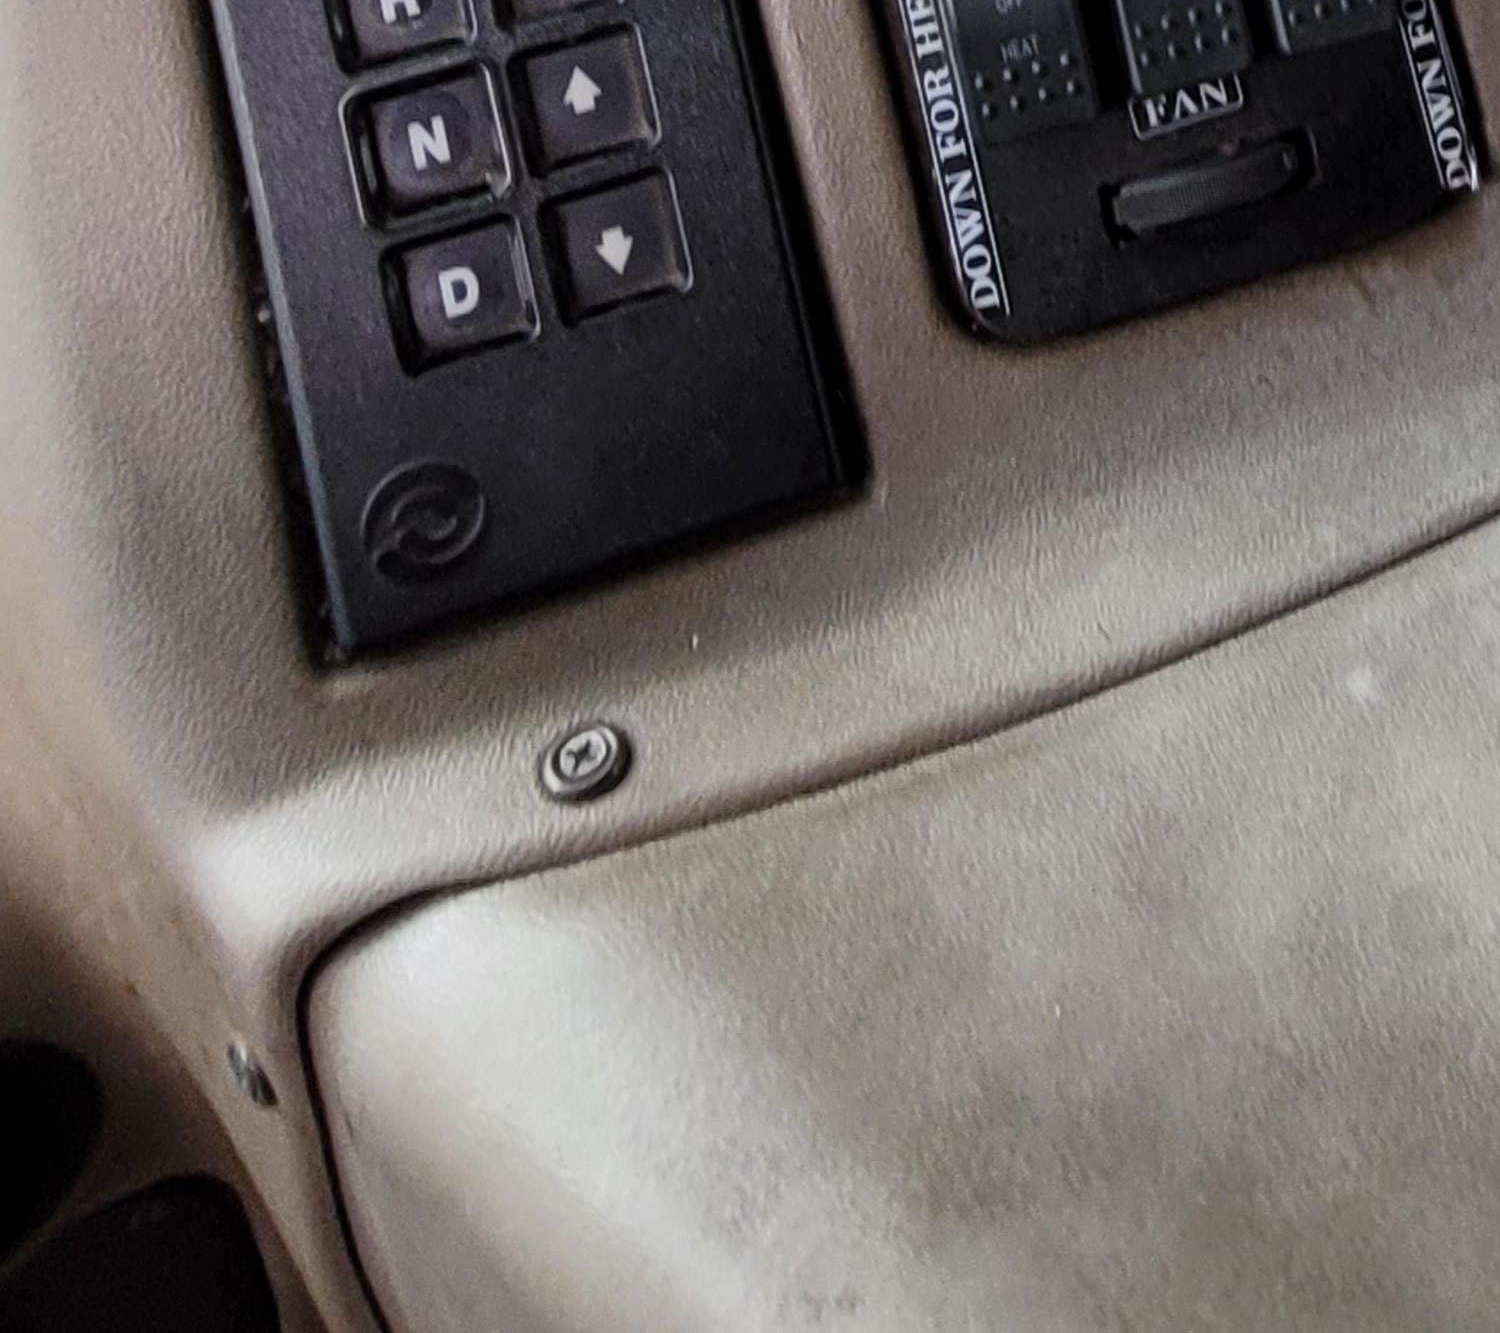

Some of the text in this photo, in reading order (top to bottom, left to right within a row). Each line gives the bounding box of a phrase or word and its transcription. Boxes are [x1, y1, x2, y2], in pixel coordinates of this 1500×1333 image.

[1000, 34, 1039, 64] HEAT
[923, 65, 967, 163] FOR
[1146, 77, 1227, 128] FAN
[1418, 57, 1472, 189] DOWN
[407, 113, 451, 171] N
[945, 169, 1000, 309] DOWN
[438, 266, 480, 320] D
